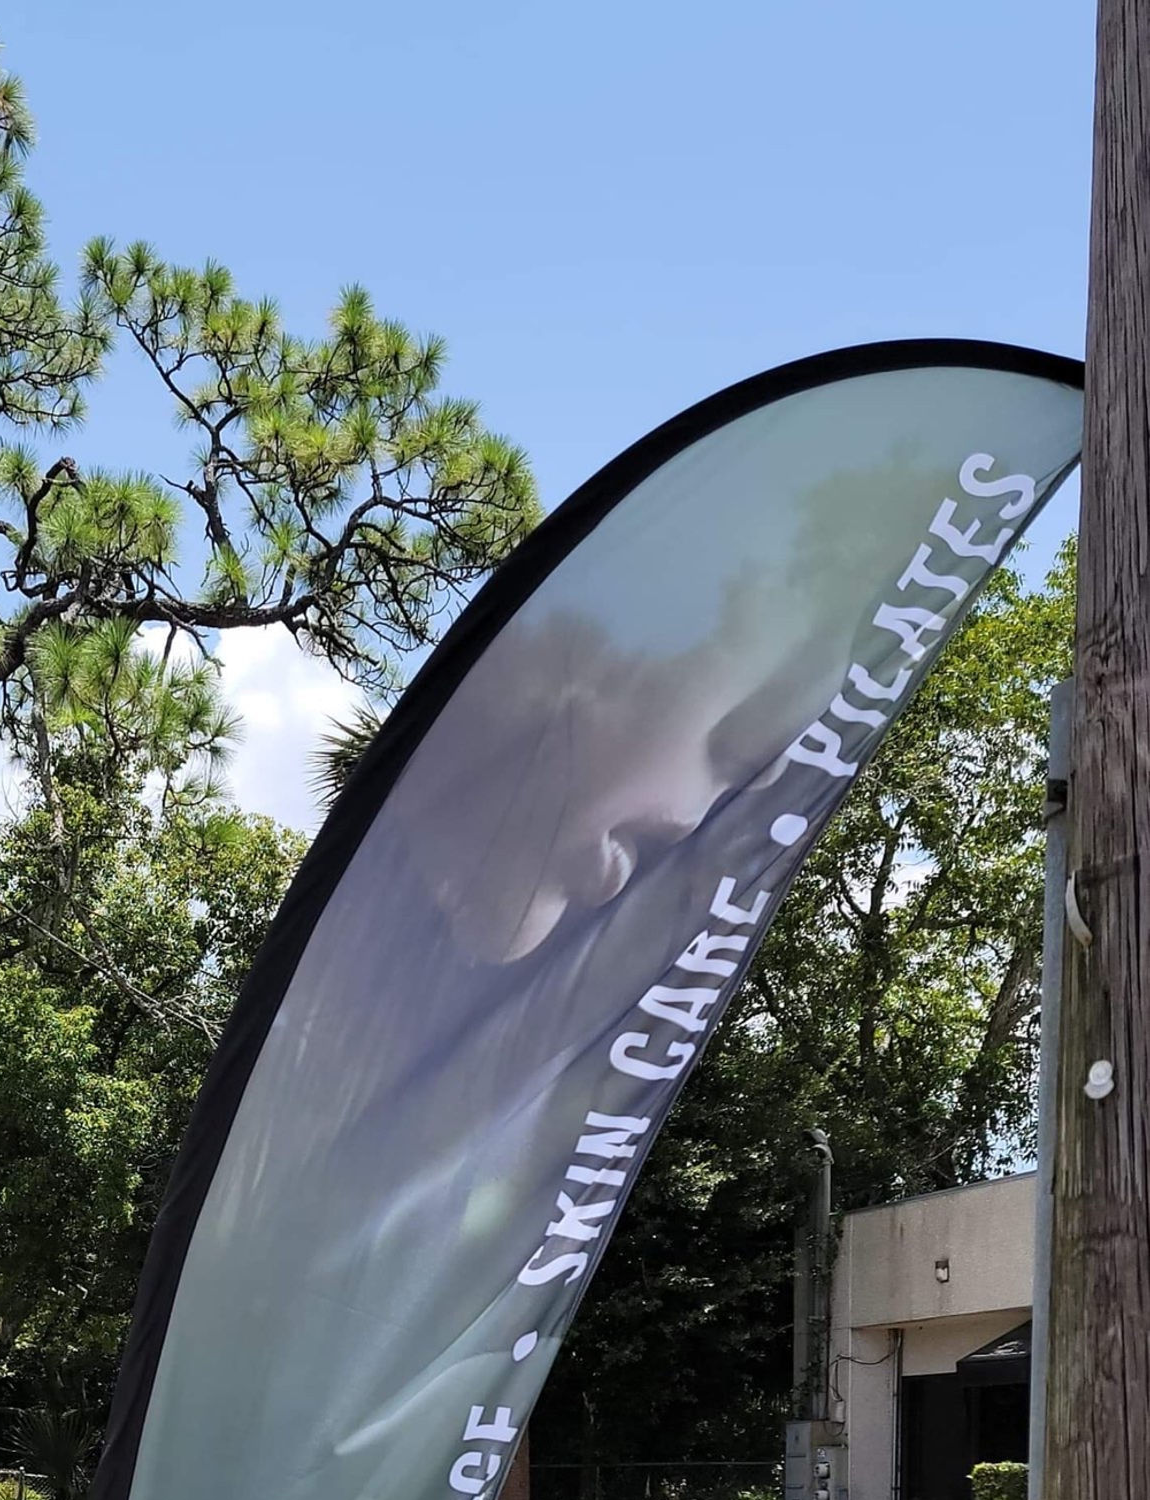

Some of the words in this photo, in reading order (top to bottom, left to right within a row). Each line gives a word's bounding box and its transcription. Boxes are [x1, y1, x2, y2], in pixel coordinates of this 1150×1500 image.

[517, 1111, 651, 1287] SKIN
[609, 876, 772, 1081] CARE
[784, 452, 1036, 778] PILATES
